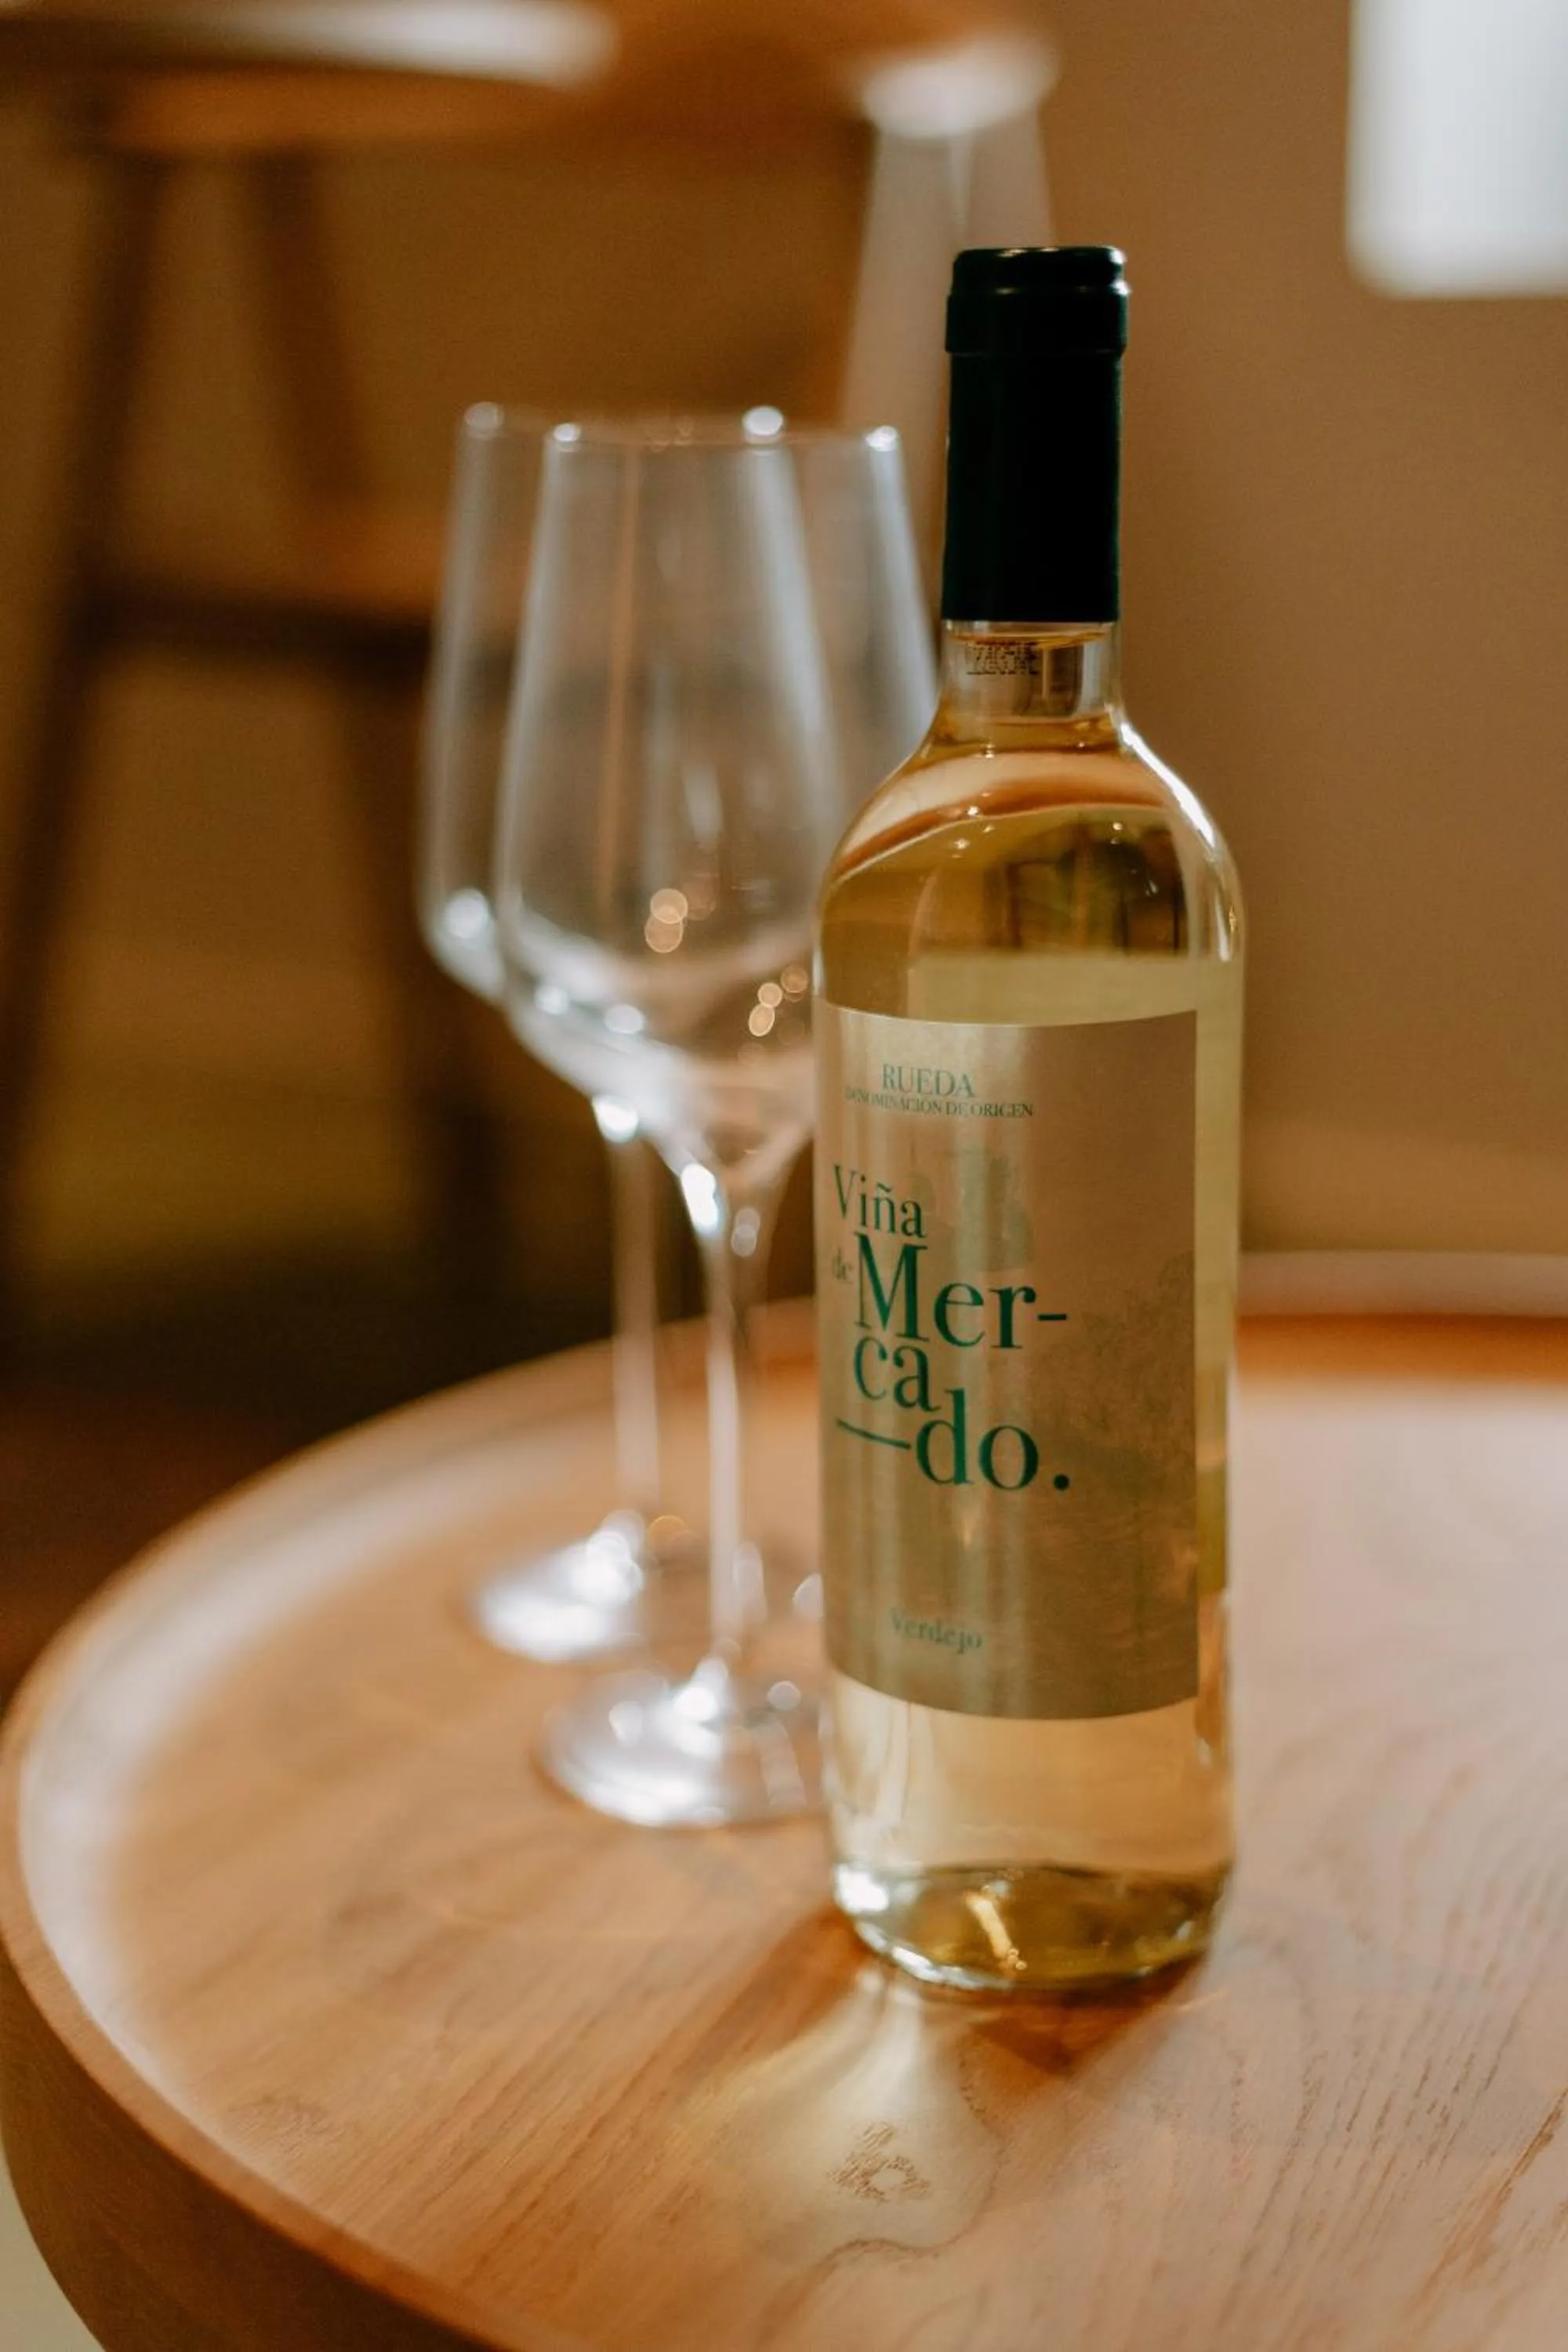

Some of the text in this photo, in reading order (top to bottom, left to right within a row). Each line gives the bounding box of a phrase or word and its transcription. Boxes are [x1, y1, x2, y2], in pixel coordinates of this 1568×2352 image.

[881, 1063, 975, 1098] RUEDA
[946, 1102, 967, 1116] DE
[971, 1103, 1033, 1118] ORIGEN
[833, 1164, 926, 1238] Viña
[854, 1231, 1067, 1349] Mer-
[854, 1336, 942, 1413] ca
[887, 1609, 982, 1655] Verdejo
